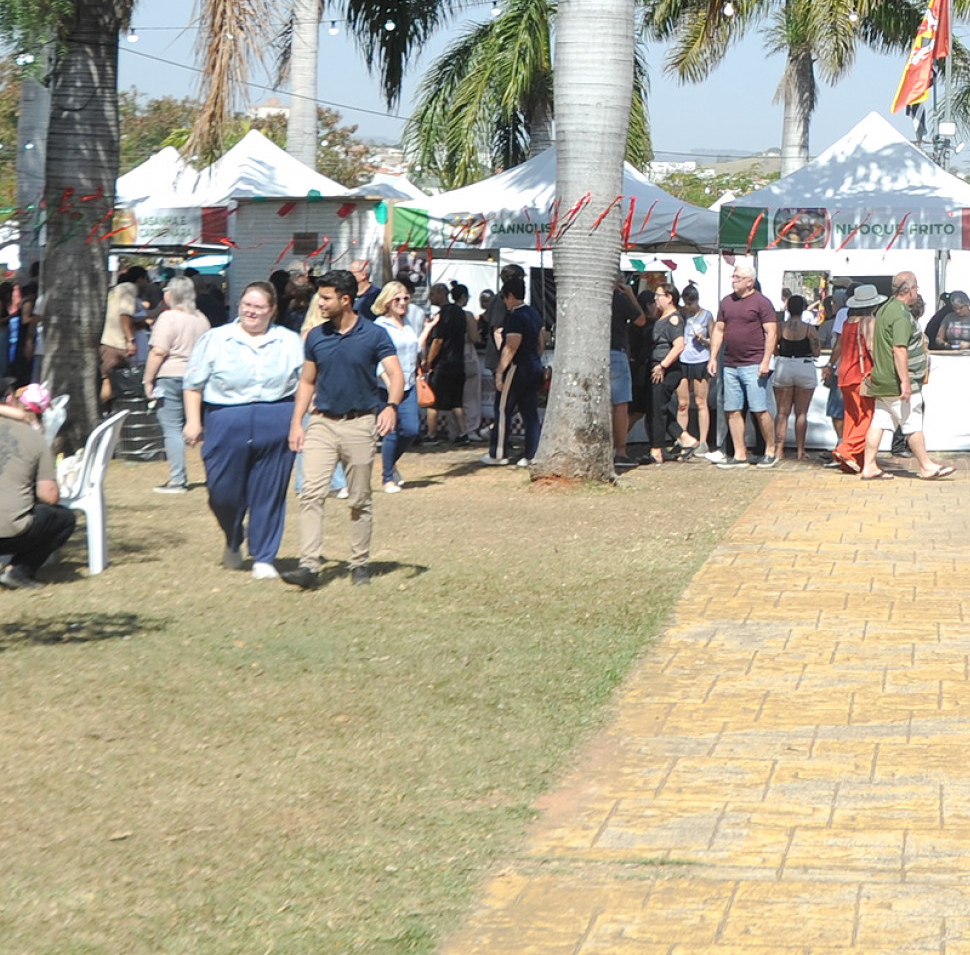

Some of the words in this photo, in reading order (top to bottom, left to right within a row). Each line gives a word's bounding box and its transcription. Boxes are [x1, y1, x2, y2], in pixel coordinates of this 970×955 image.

[491, 223, 552, 234] CANNOLIS
[836, 224, 904, 237] NHOQUE
[909, 224, 955, 235] FRITO
